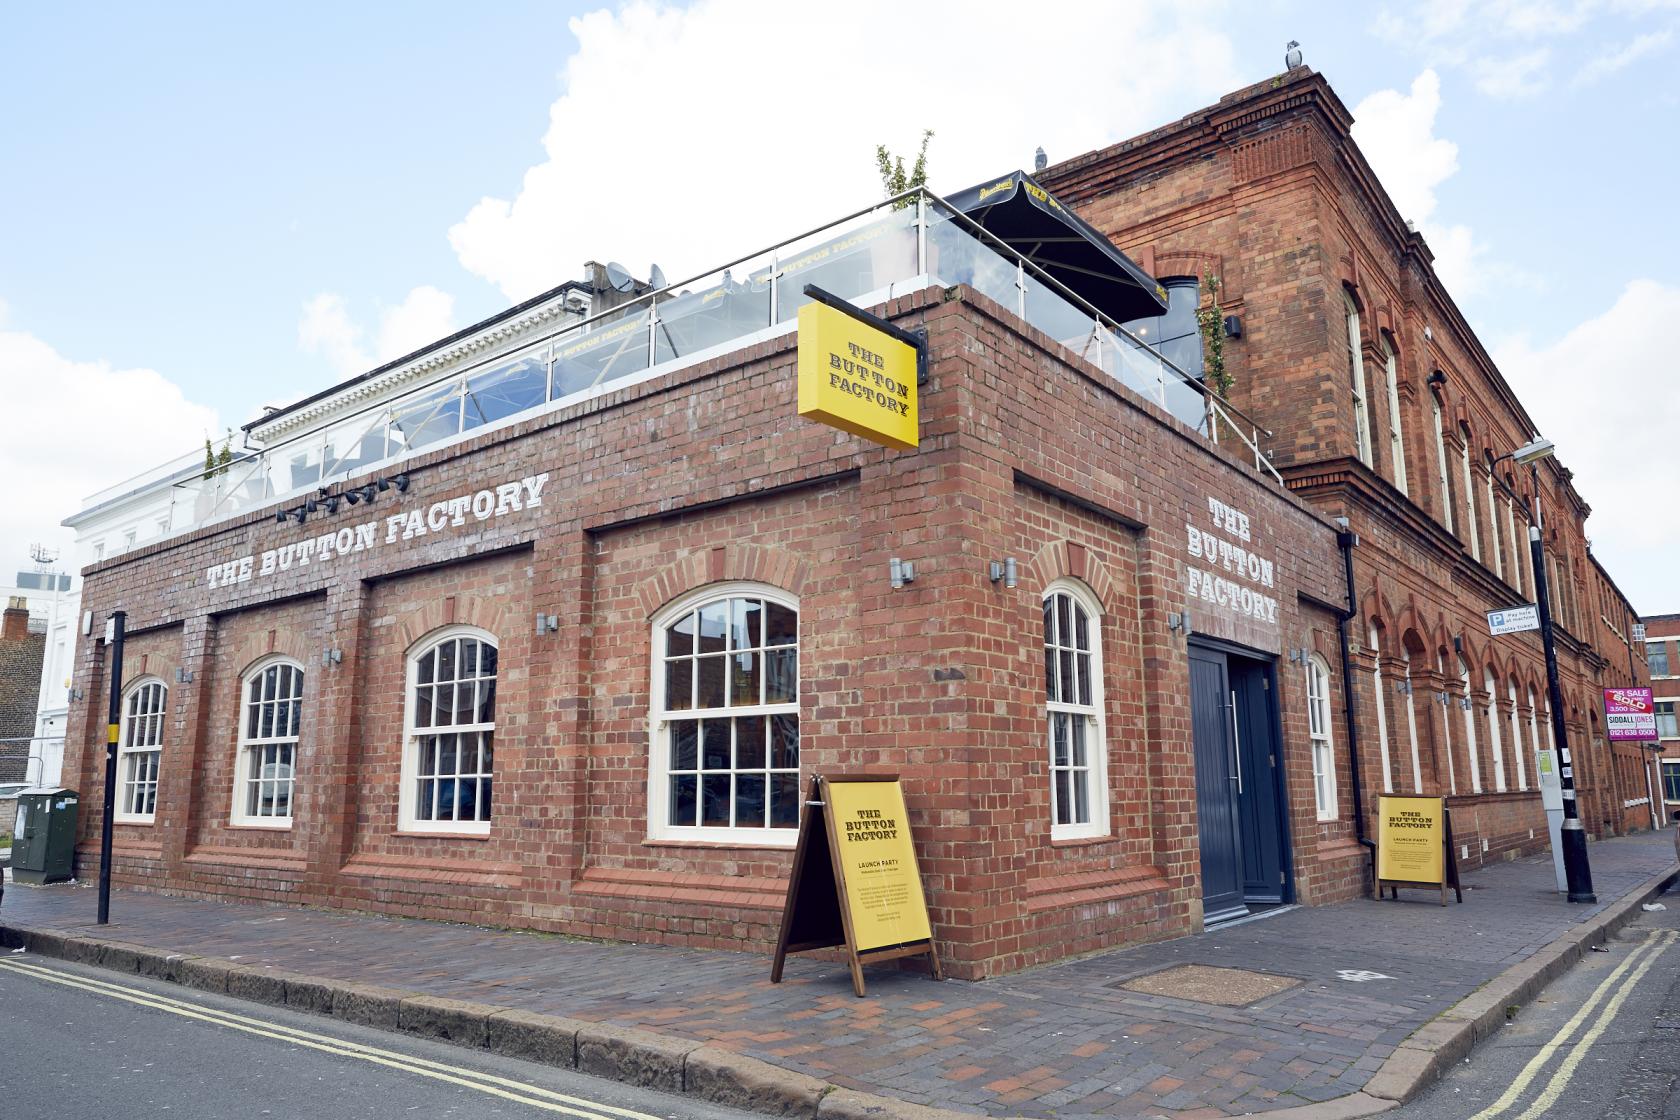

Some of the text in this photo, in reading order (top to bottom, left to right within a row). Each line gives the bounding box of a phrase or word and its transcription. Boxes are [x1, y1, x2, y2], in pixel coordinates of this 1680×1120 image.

[848, 341, 885, 370] THE
[829, 352, 909, 399] BUTTON
[829, 372, 910, 417] FACTORY
[1208, 496, 1251, 542] THE
[206, 473, 549, 589] THE BUTTON FACTORY
[1186, 523, 1274, 588] BUTTON
[1187, 566, 1277, 624] FACTORY
[1613, 694, 1646, 710] SOLD
[1627, 689, 1649, 697] SALE
[1609, 716, 1634, 724] SIDDALL
[845, 819, 896, 831] BUTTON
[857, 809, 881, 819] THE
[847, 830, 898, 842] FACTORY
[858, 859, 899, 869] LAUNCH PARTY
